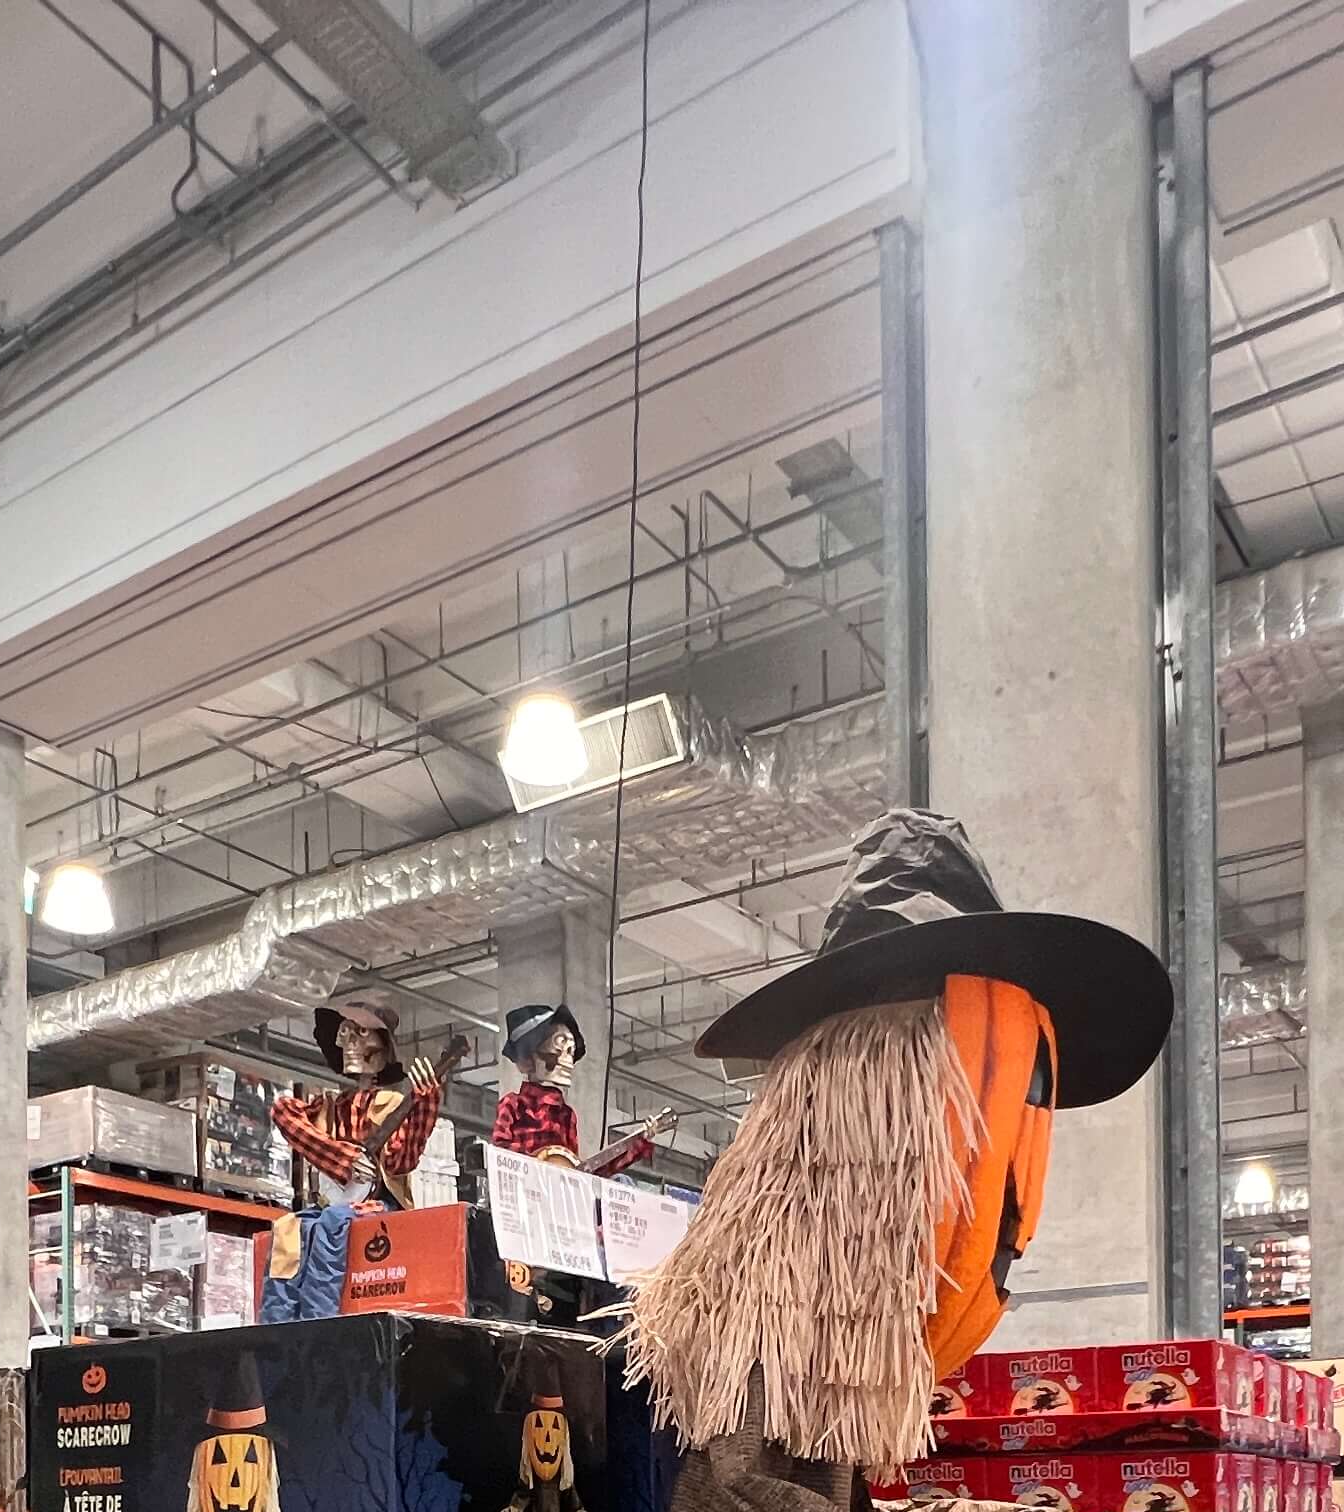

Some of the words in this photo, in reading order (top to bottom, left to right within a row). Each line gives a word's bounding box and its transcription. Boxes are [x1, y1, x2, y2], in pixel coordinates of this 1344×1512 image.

[350, 1281, 406, 1299] SCARECROW
[1010, 1353, 1072, 1377] nutella
[1122, 1346, 1190, 1371] nutella
[58, 1404, 103, 1423] PUMPKIN
[106, 1402, 131, 1421] HEAD
[57, 1424, 131, 1448] SCARECROW
[1000, 1419, 1056, 1439] nutella
[906, 1462, 964, 1482] nutella
[1010, 1460, 1073, 1482] nutella
[1121, 1457, 1190, 1480] nutella
